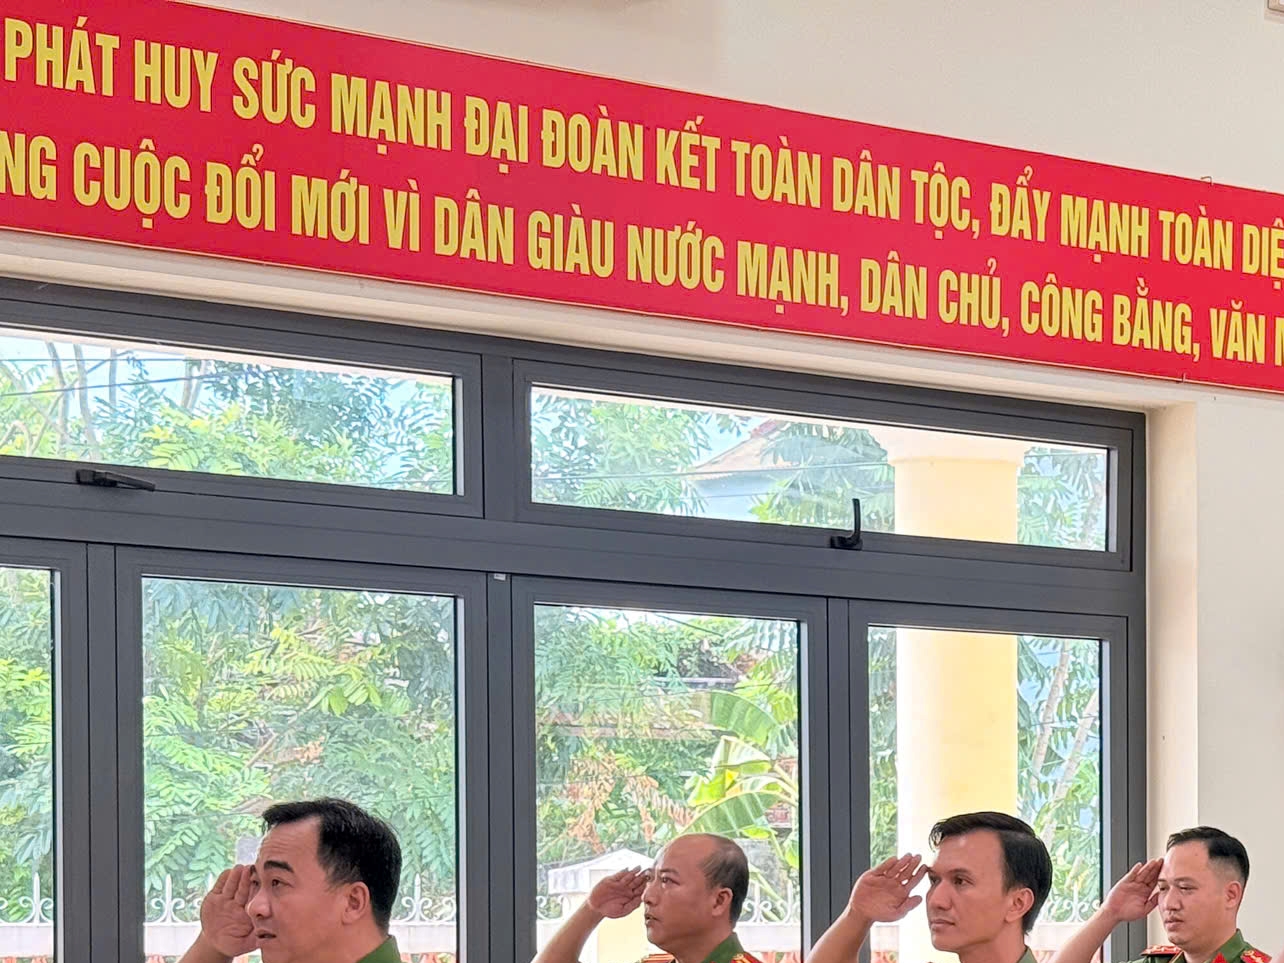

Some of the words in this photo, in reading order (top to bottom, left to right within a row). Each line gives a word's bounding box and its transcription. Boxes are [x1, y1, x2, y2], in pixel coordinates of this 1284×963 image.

[5, 17, 119, 96] PHÁT
[135, 40, 218, 112] HUY
[233, 50, 315, 128] SỨC
[332, 74, 451, 154] MẠNH
[464, 96, 528, 173] ĐẠI
[541, 106, 643, 180] ĐOÀN
[657, 116, 720, 191] KẾT
[732, 136, 820, 208] TOÀN
[833, 150, 900, 219] DÂN
[911, 162, 979, 238] TỘC,
[990, 166, 1050, 241] ĐẨY
[1061, 195, 1149, 262] MẠNH
[1159, 206, 1232, 270] TOÀN
[74, 139, 190, 228] CUỘC
[205, 144, 275, 230] ĐỔI
[292, 170, 368, 244] MỚI
[384, 180, 419, 251] VÌ
[435, 189, 513, 264] DÂN
[528, 204, 613, 277] GIÀU
[628, 222, 724, 292] NƯỚC
[738, 241, 848, 315] MẠNH,
[861, 251, 926, 319] DÂN
[939, 259, 1009, 336] CHỦ,
[1021, 274, 1102, 341] CÔNG
[1113, 278, 1199, 361] BẰNG,
[1210, 301, 1265, 363] VĂN
